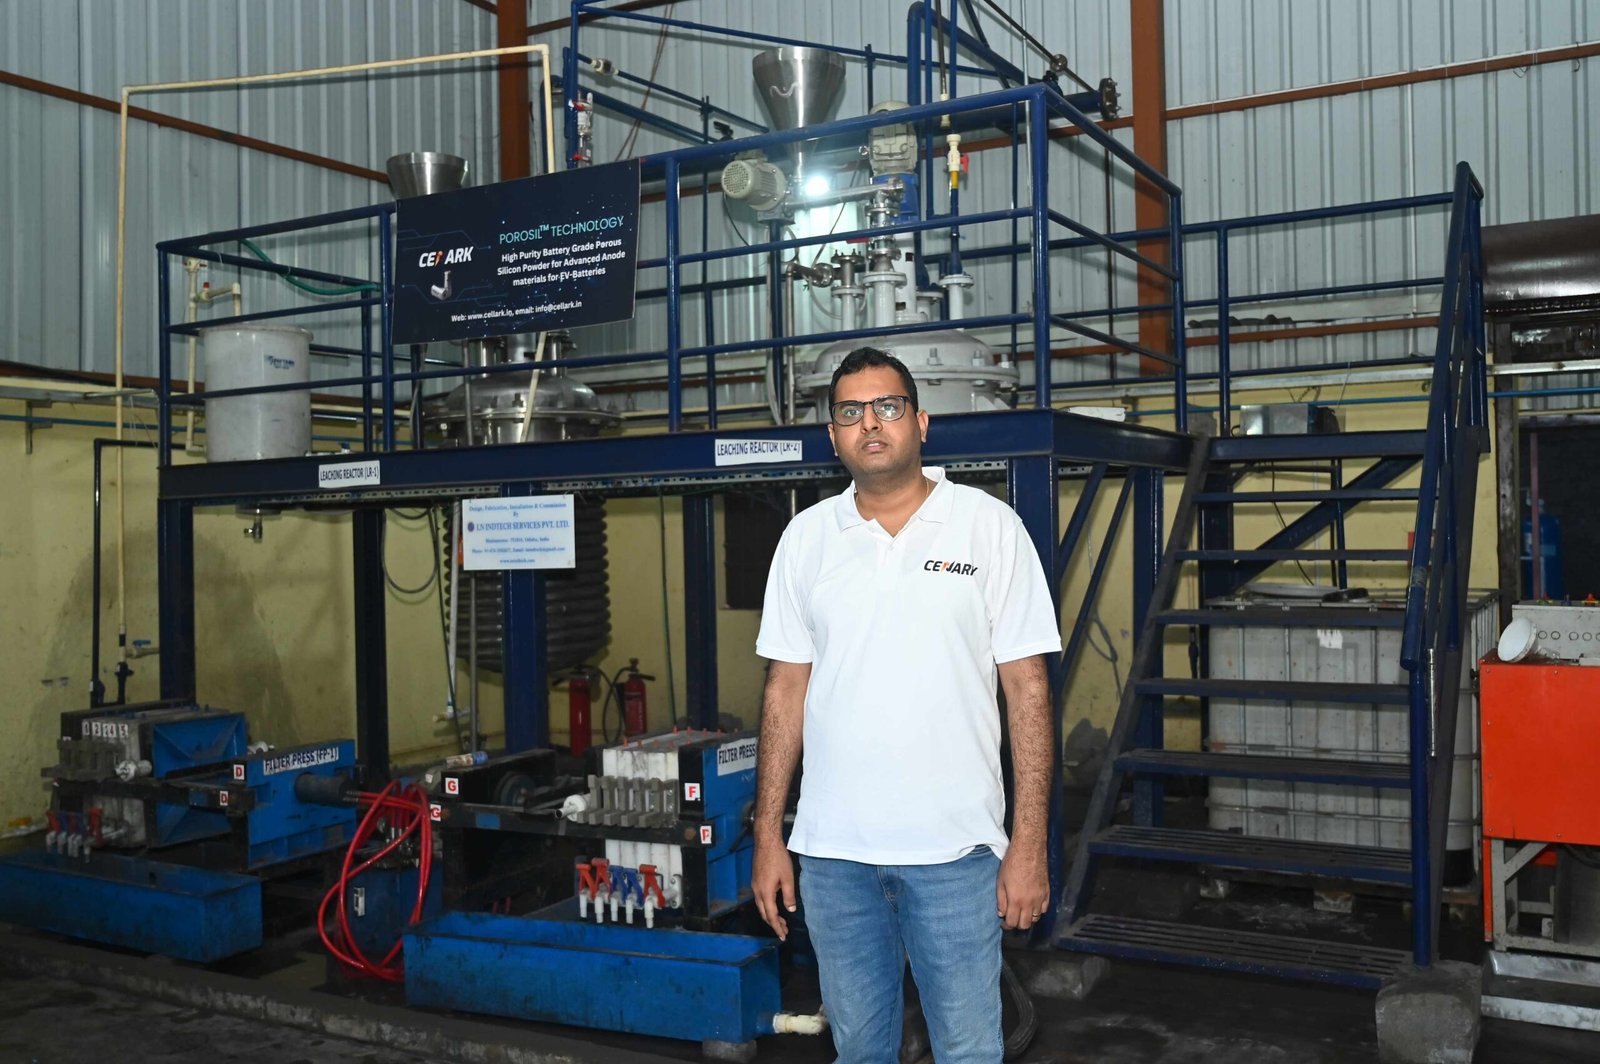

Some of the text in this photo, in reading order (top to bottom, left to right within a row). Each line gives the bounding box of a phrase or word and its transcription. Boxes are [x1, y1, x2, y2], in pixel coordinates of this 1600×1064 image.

[551, 216, 624, 237] TECHNOLOGY
[502, 238, 622, 263] High Purity Battery Grade Porous
[497, 250, 626, 276] Silicon Powder for Advanced Anode
[512, 267, 606, 286] materials for EV-Batteries
[515, 306, 534, 315] email:
[535, 300, 582, 312] info@cellark.in
[718, 442, 748, 456] LEACHING
[750, 442, 778, 454] REACTOR
[320, 470, 342, 480] LEACHING
[344, 468, 364, 479] REACTOR
[485, 522, 512, 531] INDTECH
[512, 522, 541, 530] SERVICES
[556, 520, 569, 528] LTD.
[265, 756, 290, 770] FILTER
[292, 751, 315, 765] PRESS
[718, 744, 756, 764] FILTER PRESS
[236, 766, 242, 776] D
[448, 780, 456, 791] G
[688, 786, 696, 798] F
[221, 793, 227, 804] D
[432, 807, 441, 818] G
